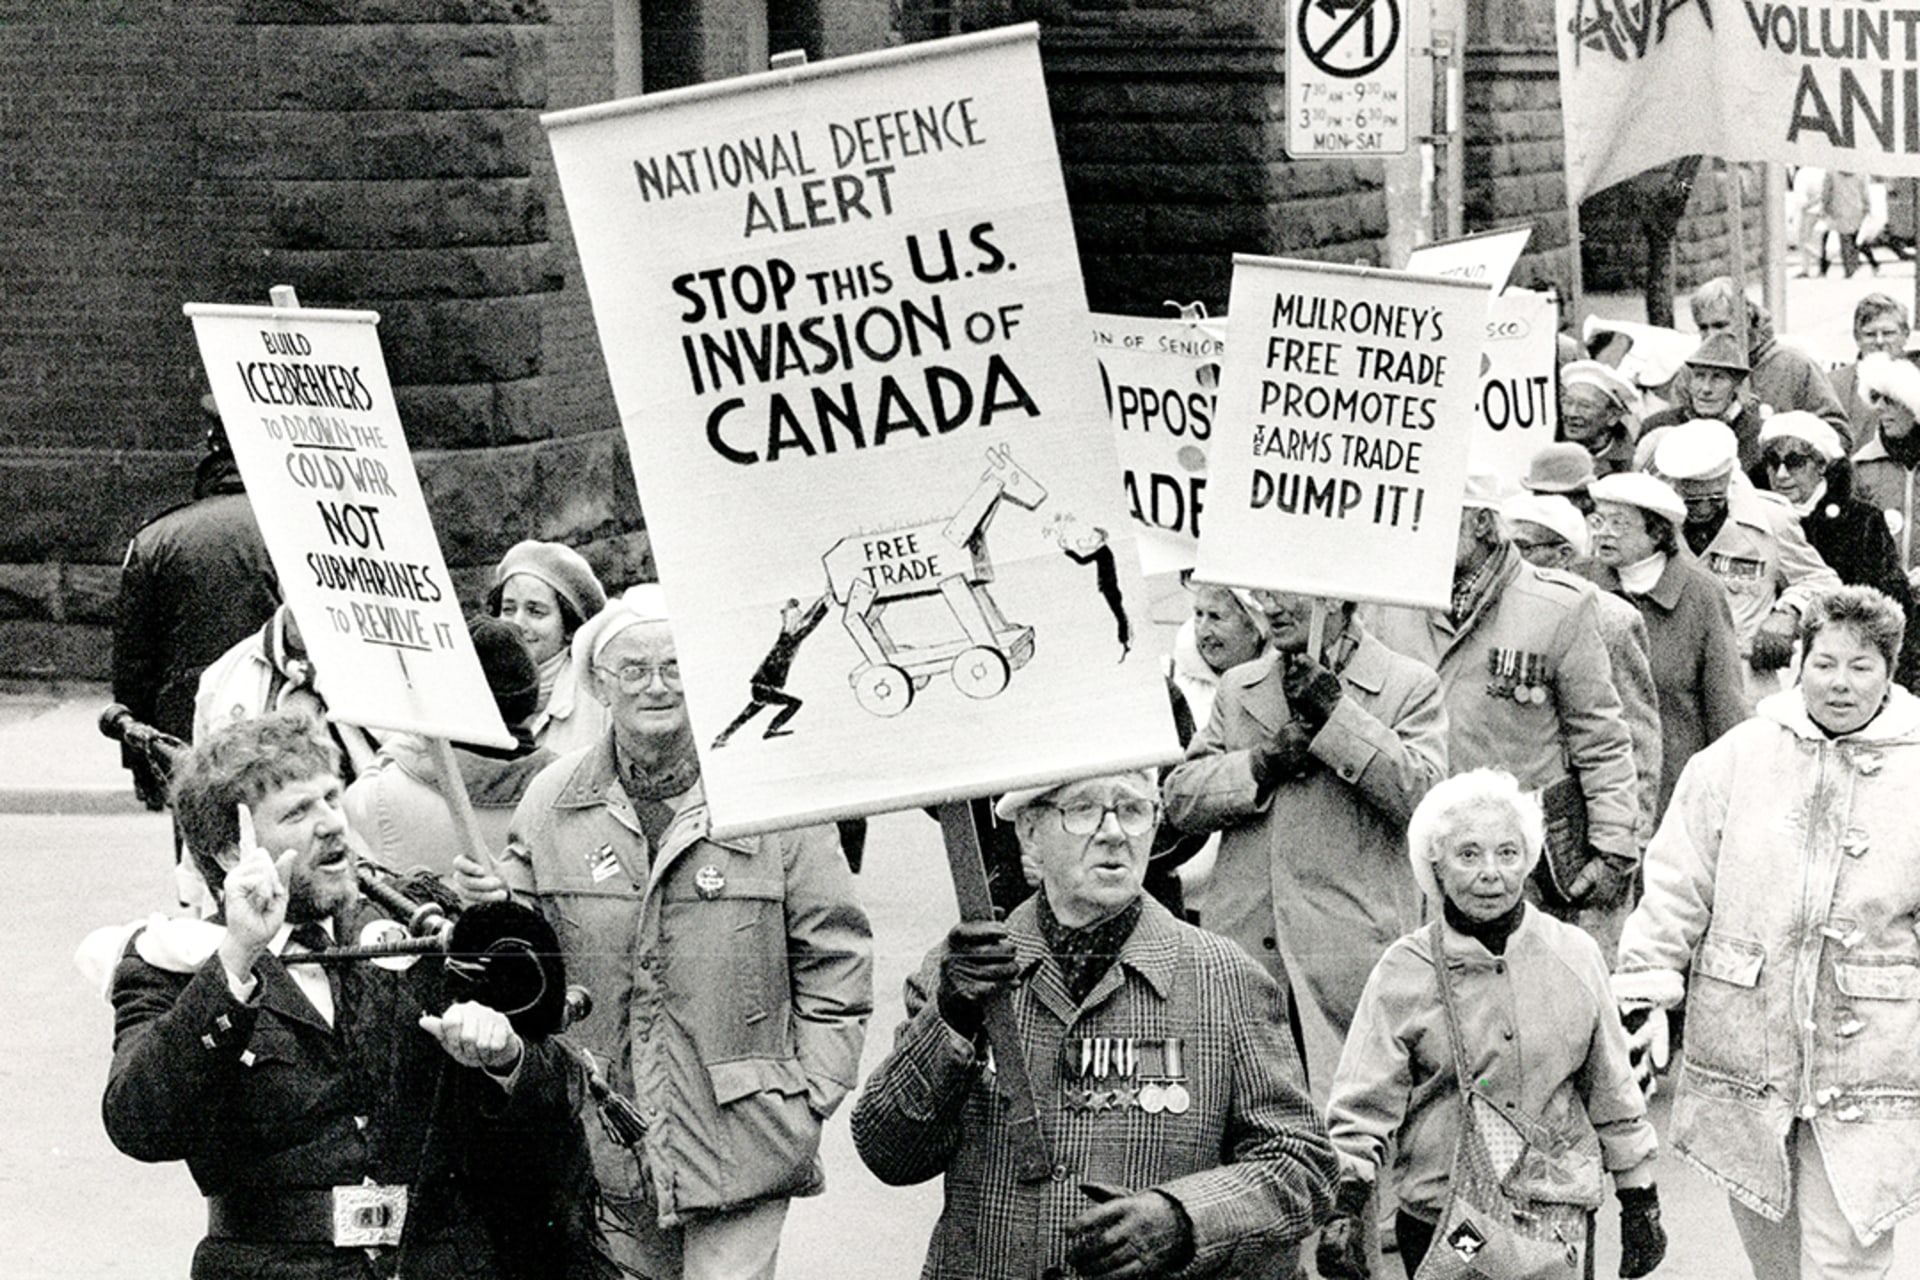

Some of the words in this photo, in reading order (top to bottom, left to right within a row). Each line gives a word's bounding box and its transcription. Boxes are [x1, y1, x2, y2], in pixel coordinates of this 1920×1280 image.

[633, 131, 816, 201] NATIONAL
[829, 97, 986, 165] DEFENCE
[743, 165, 896, 238] ALERT
[671, 258, 796, 324] STOP
[806, 261, 893, 306] THIS
[906, 222, 1017, 284] U.S.
[1124, 335, 1145, 348] OF
[1272, 293, 1443, 342] MULRONEY'S
[260, 330, 312, 356] BUILD
[682, 294, 950, 395] INVASION
[964, 304, 1024, 344] OF
[1266, 336, 1342, 376] FREE
[1356, 346, 1447, 388] TRADE
[236, 360, 373, 412] ICEBREAKERS
[706, 354, 1041, 465] CANADA
[1260, 380, 1437, 430] PROMOTES
[261, 417, 283, 441] TO
[281, 414, 352, 449] DROWN
[350, 425, 388, 449] THE
[1264, 426, 1332, 464] ARMS
[1341, 433, 1422, 474] TRADE
[285, 452, 345, 491] COLD
[347, 460, 397, 498] WAR
[316, 500, 385, 551] NOT
[1250, 469, 1362, 519] DUMP
[1373, 484, 1425, 532] IT!
[863, 533, 919, 562] FREE
[863, 555, 942, 588] TRADE
[305, 552, 441, 603] SUBMARINES
[325, 605, 351, 634] TO
[349, 601, 430, 646] REVIVE
[435, 623, 455, 650] IT
